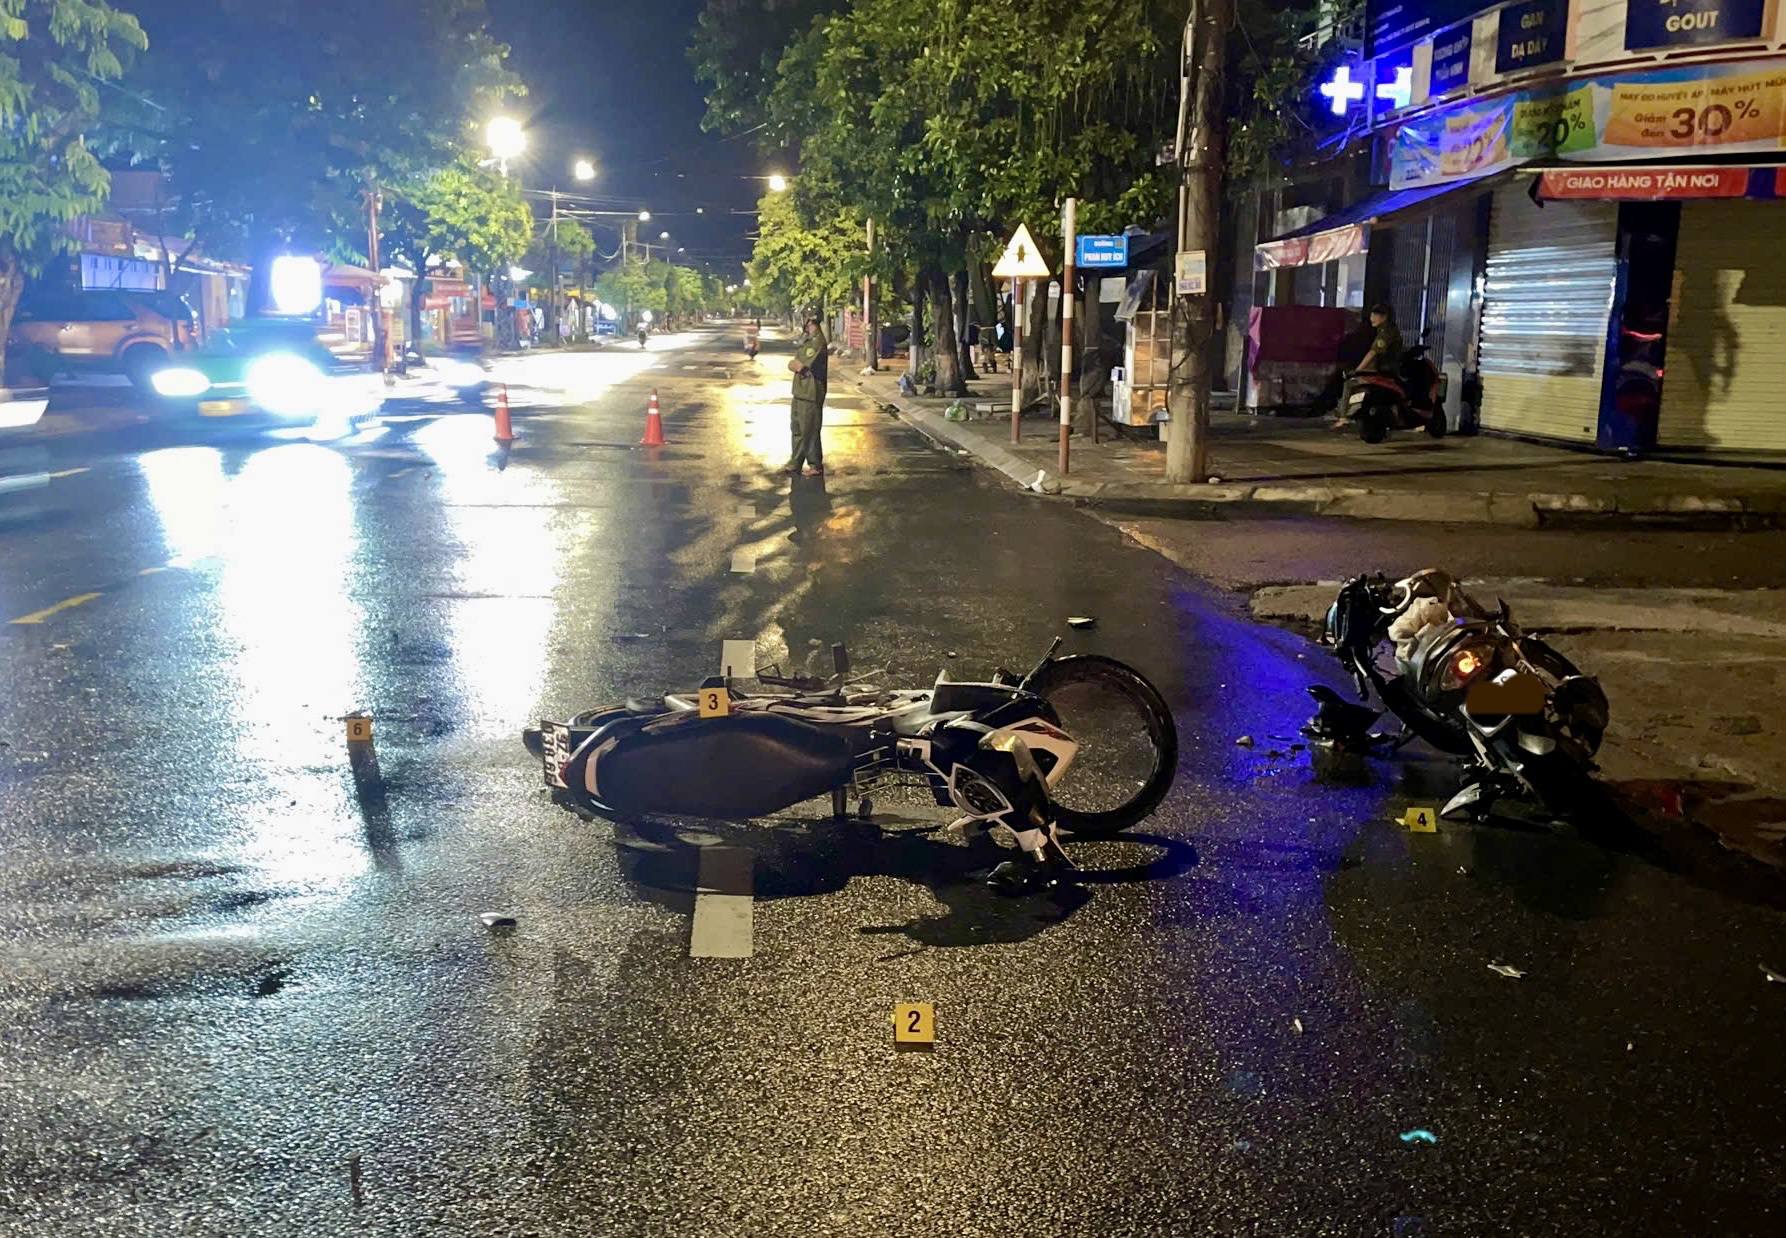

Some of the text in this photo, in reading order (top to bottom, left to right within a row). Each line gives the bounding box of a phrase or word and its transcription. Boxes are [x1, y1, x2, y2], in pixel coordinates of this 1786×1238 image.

[1665, 11, 1719, 32] GOUT
[1566, 173, 1719, 192] GIAO HÀNG TẬN NƠI
[708, 693, 718, 710] 3
[353, 722, 362, 736] 6
[1417, 812, 1427, 827] 4
[908, 1010, 921, 1033] 2
